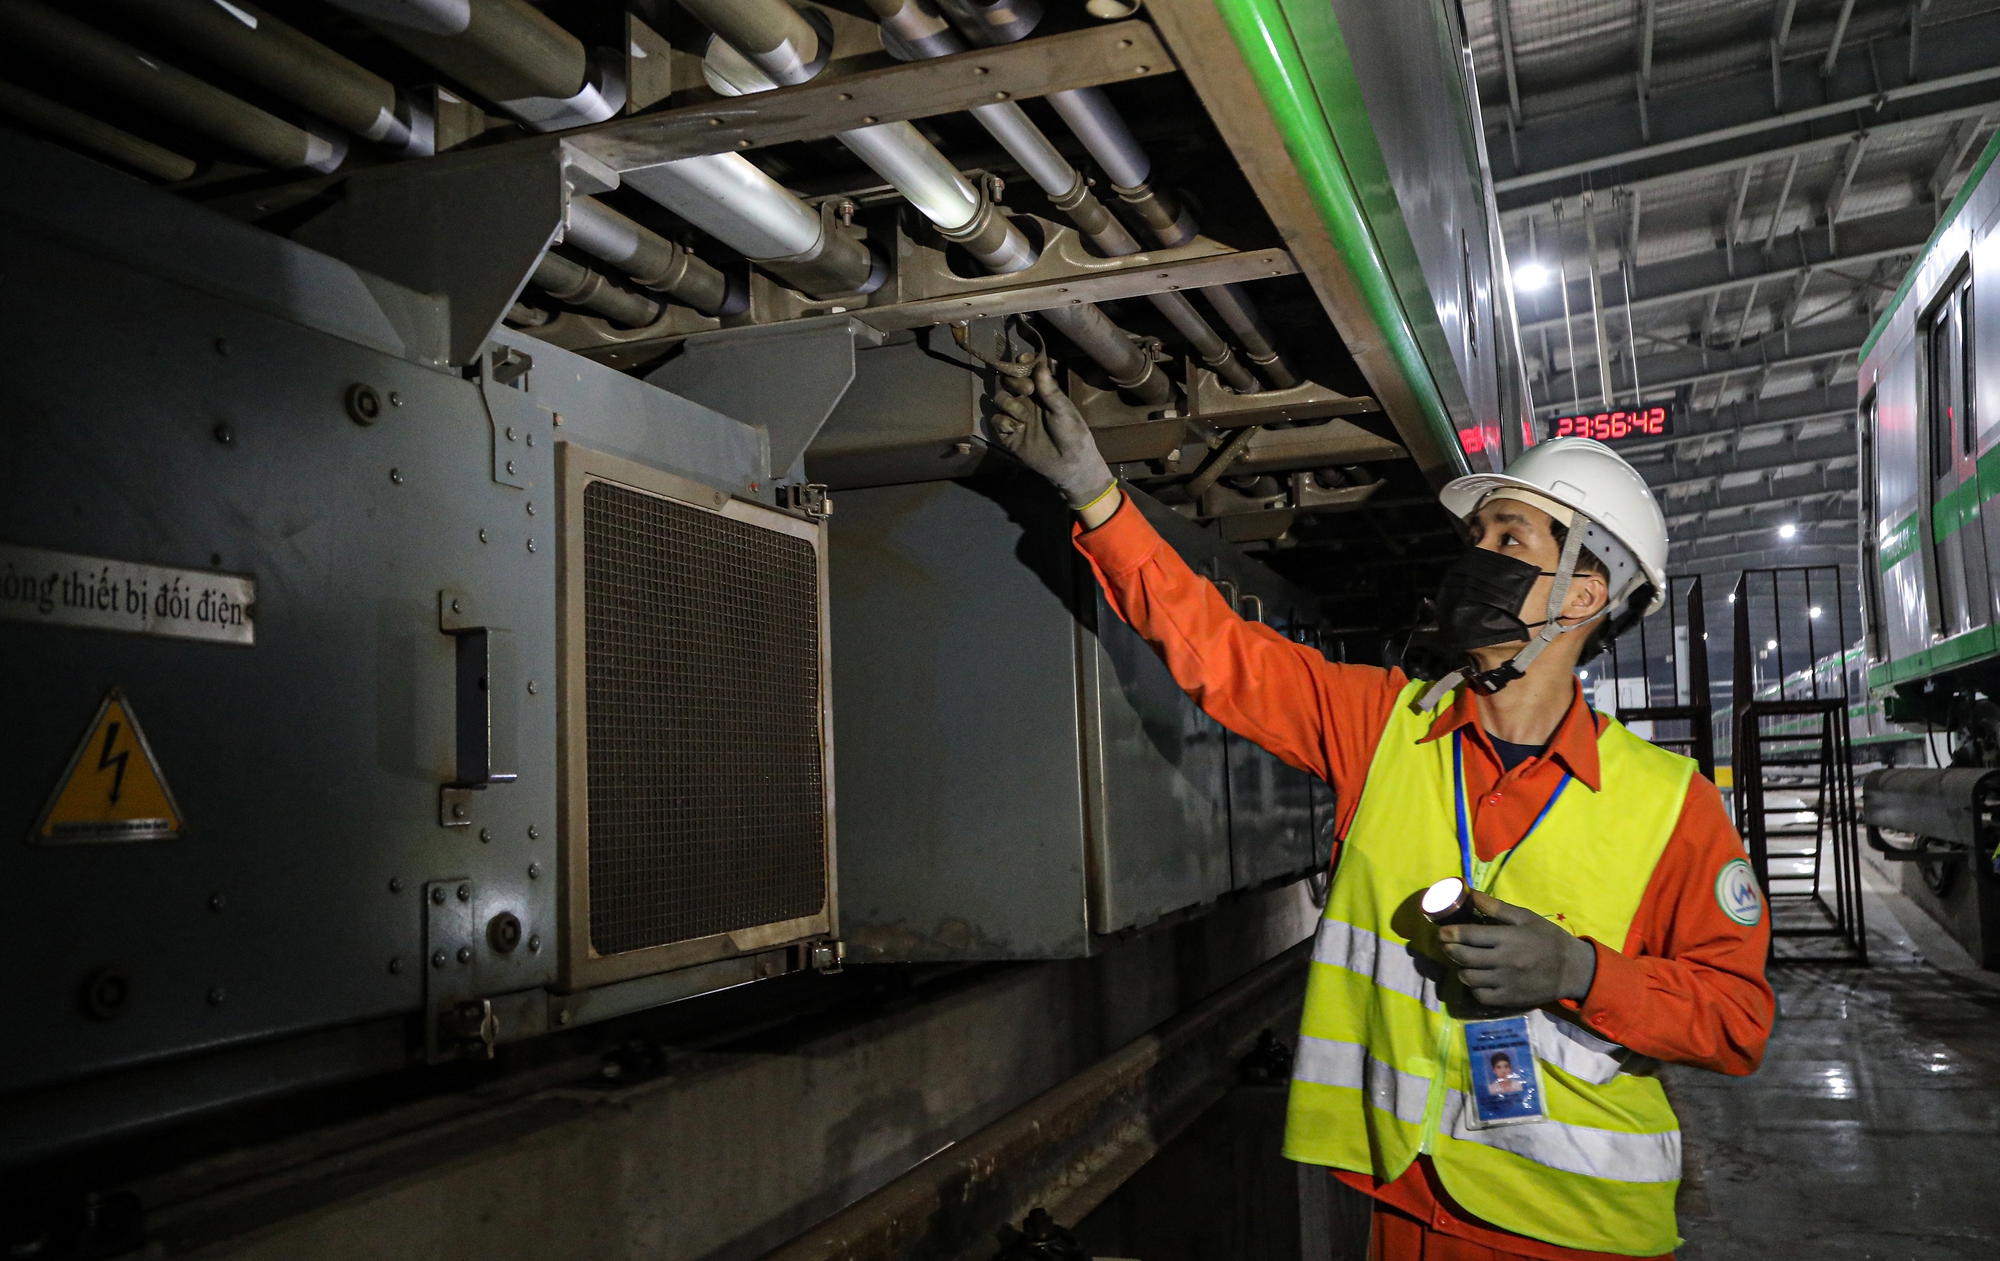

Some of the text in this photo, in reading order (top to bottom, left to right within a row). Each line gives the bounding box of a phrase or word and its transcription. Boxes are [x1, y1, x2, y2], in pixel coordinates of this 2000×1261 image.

[1556, 407, 1665, 439] 23:56:42
[0, 563, 242, 629] òng thiết bị đối điện
